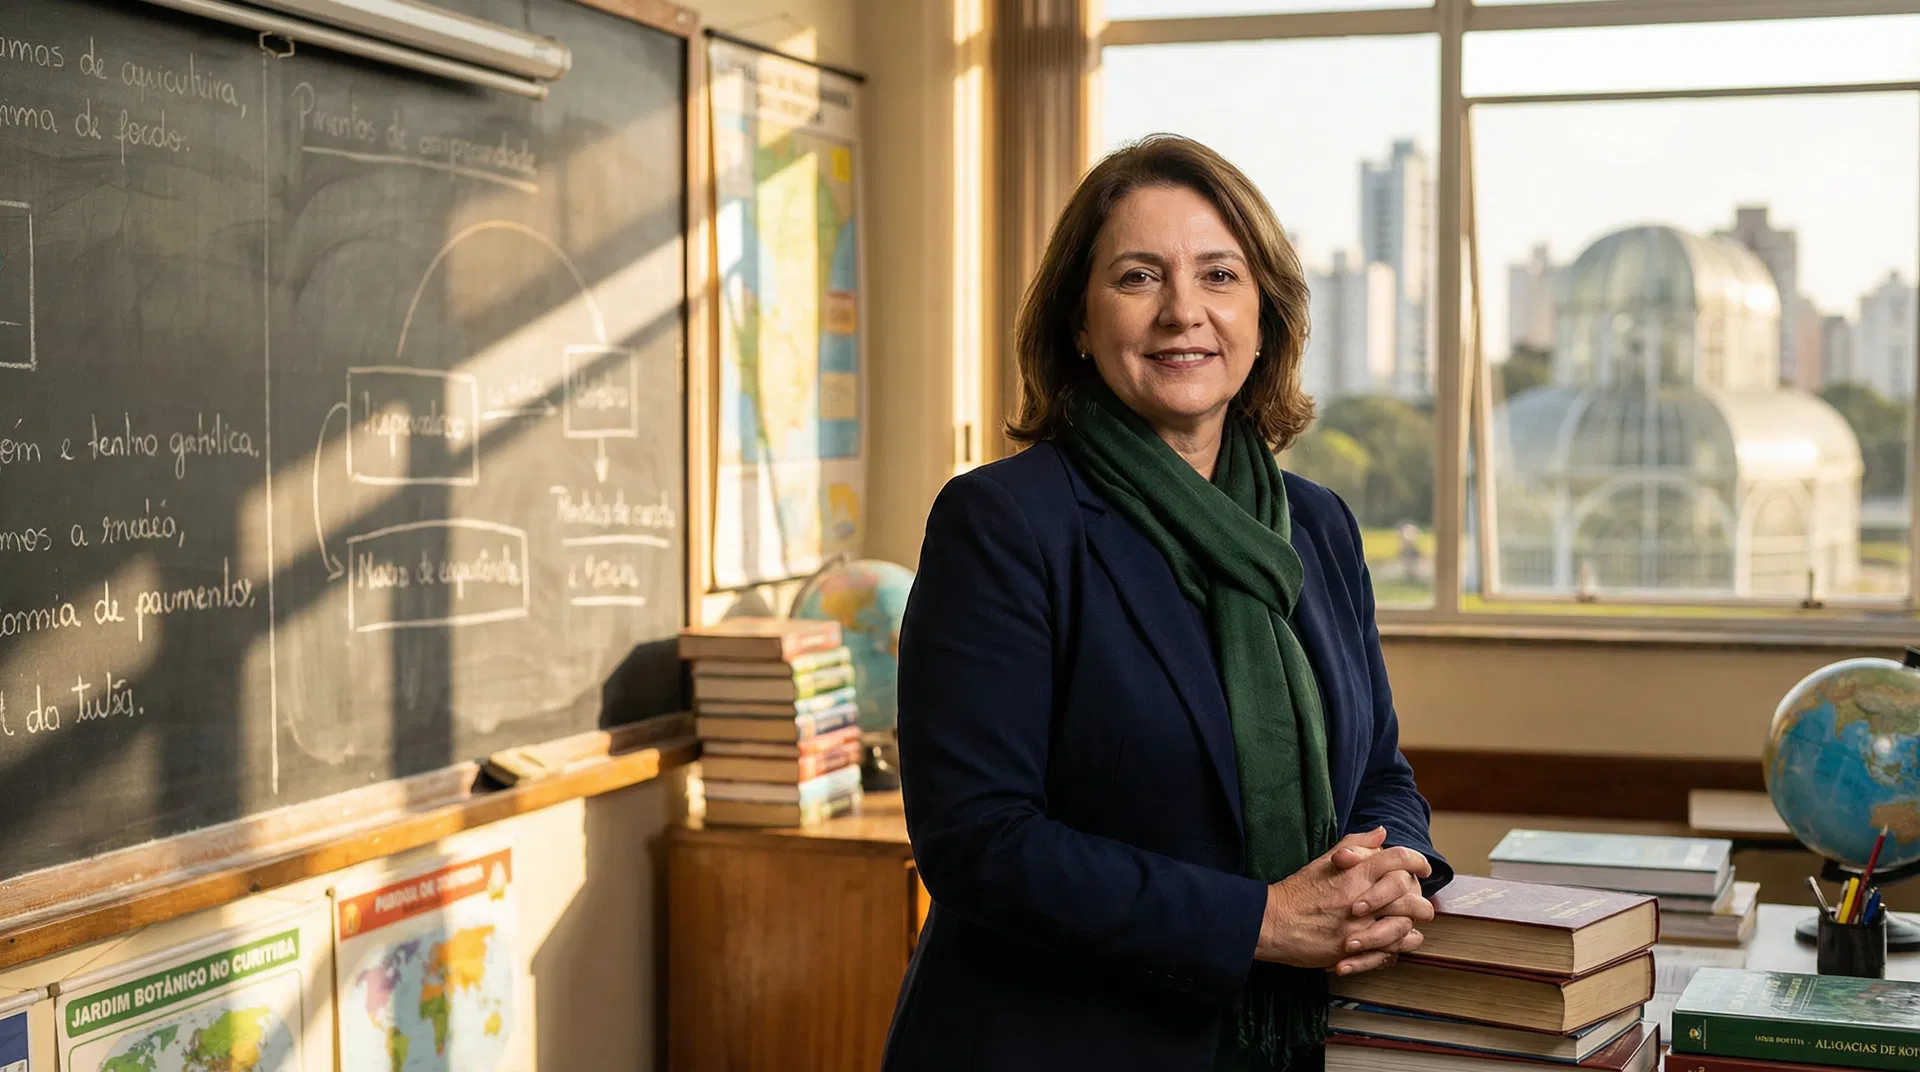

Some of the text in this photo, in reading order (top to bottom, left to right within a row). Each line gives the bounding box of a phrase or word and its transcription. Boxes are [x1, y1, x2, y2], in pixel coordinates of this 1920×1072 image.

[80, 35, 107, 80] de
[75, 98, 102, 140] de
[70, 523, 89, 547] a
[94, 579, 125, 625] de
[71, 992, 131, 1029] JARDIM
[209, 959, 230, 983] NO
[232, 936, 297, 975] CURITIBA
[1880, 1044, 1896, 1056] DE
